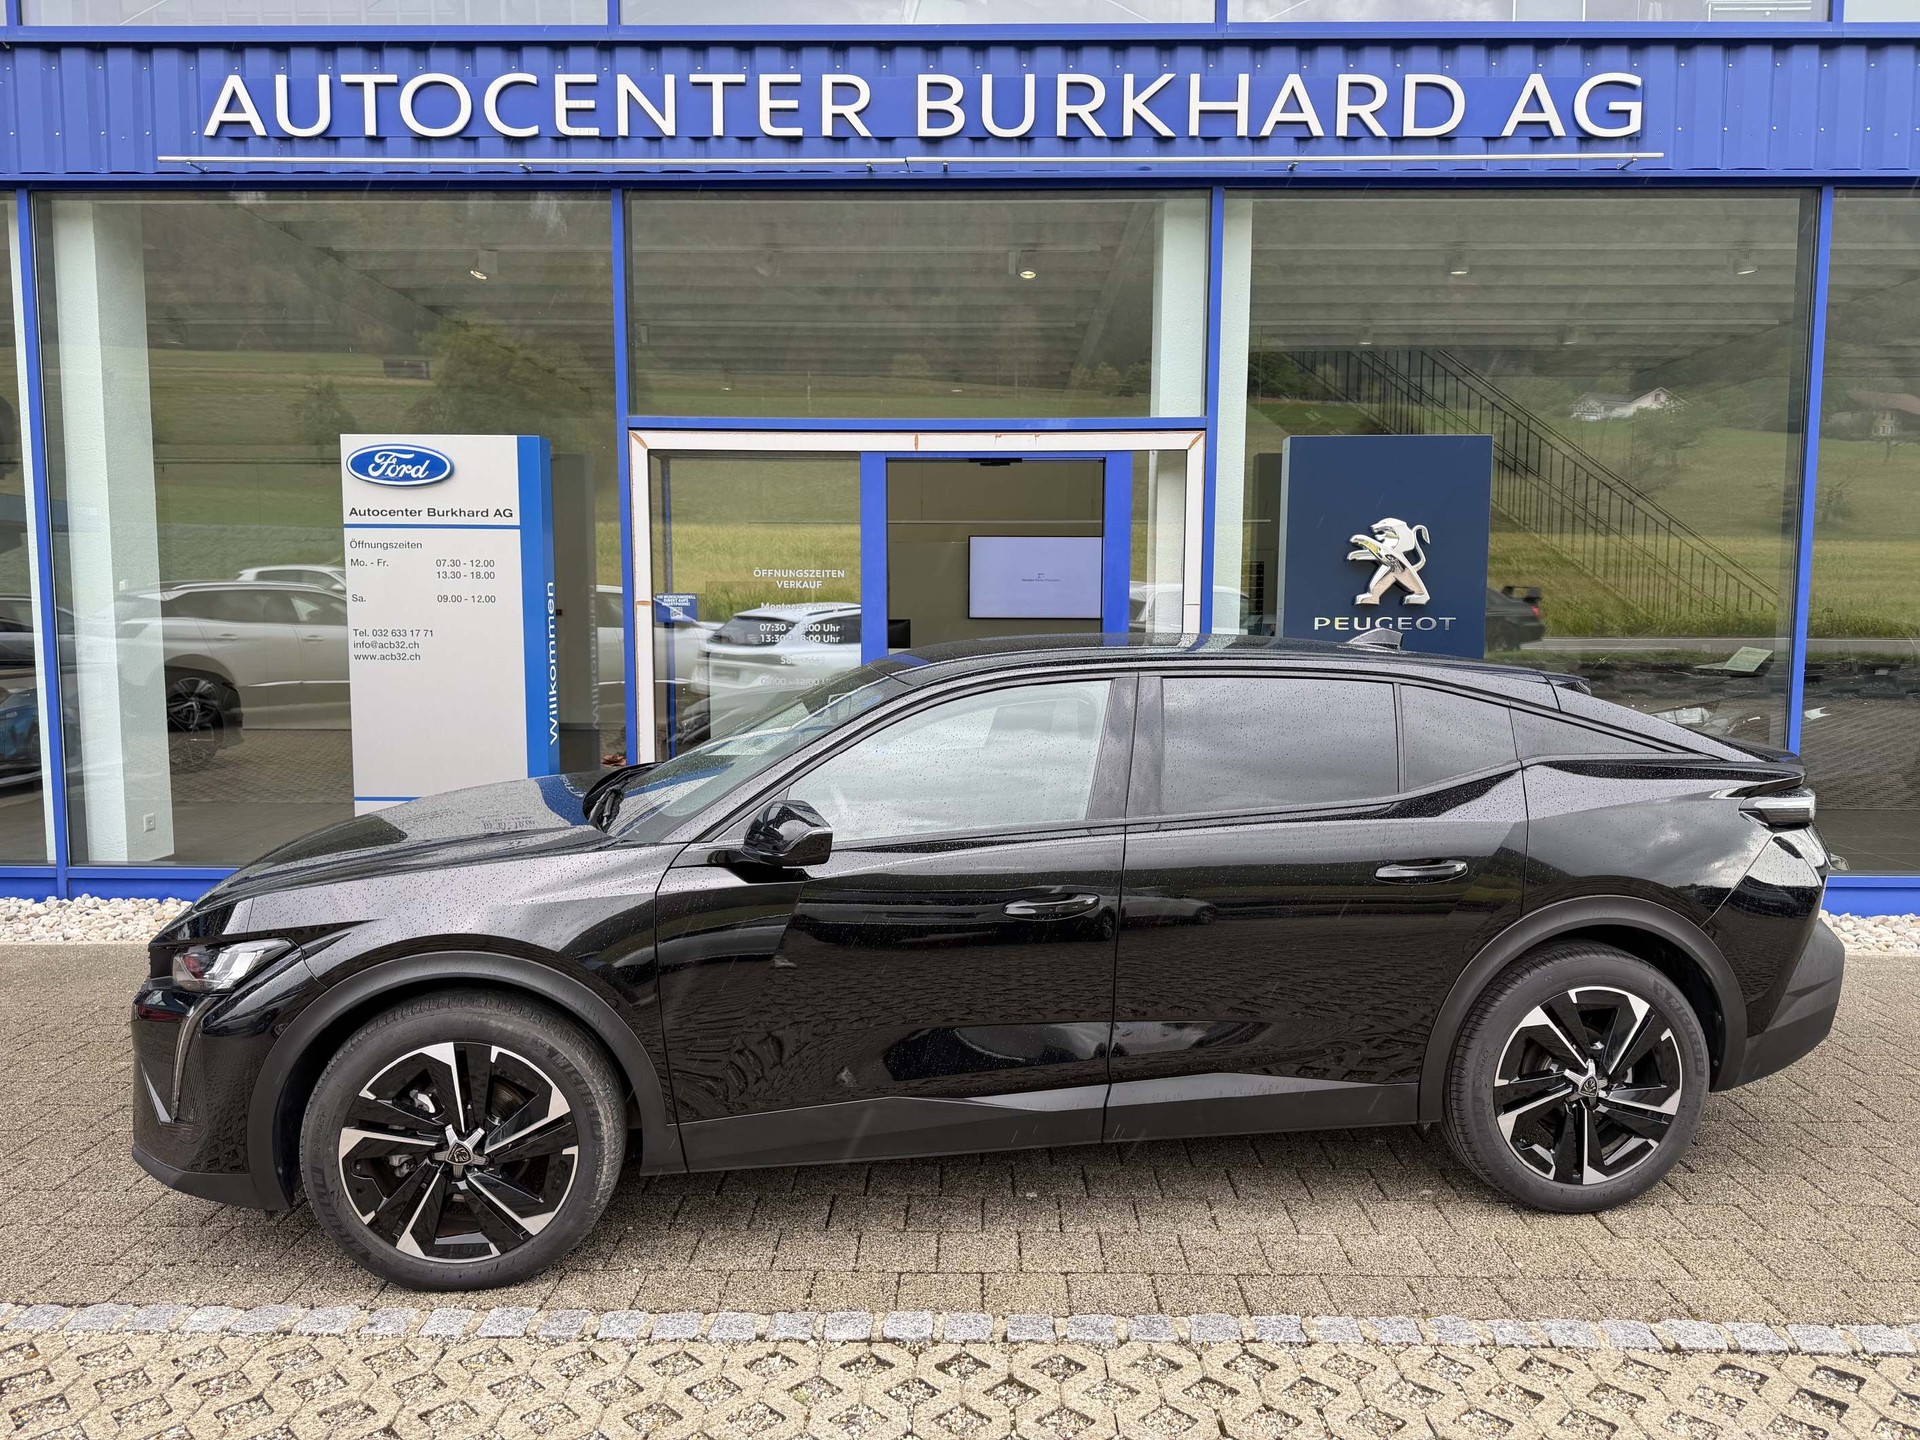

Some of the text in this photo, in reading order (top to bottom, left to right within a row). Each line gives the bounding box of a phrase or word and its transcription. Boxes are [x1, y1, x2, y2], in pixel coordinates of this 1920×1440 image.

[203, 72, 1643, 138] AUTOCENTER BURKHARD AG
[367, 451, 430, 478] Ford
[348, 507, 514, 518] Autocenter Burkhard AG
[349, 538, 423, 550] Öffnungszeiten
[350, 558, 368, 567] Mo.
[376, 558, 389, 567] Fr.
[435, 559, 461, 568] 07.30
[469, 559, 495, 568] 12.00
[436, 571, 462, 580] 13.30
[470, 571, 496, 580] 18.00
[753, 567, 845, 578] ÖFFNUNGSZEITEN
[776, 580, 822, 589] VERKAUF
[351, 594, 367, 603] Sa.
[437, 595, 463, 604] 09.00
[471, 595, 496, 604] 12.00
[759, 623, 786, 632] 07:30
[822, 623, 840, 632] Uhr
[1314, 616, 1457, 631] PEUGEOT
[353, 628, 434, 638] Tel. 032 633 17 71
[760, 634, 786, 643] 13:30
[822, 634, 840, 643] Uhr
[353, 640, 420, 650] info@acb32.ch
[353, 653, 421, 661] www.acb32.ch
[547, 582, 558, 746] Willkommen
